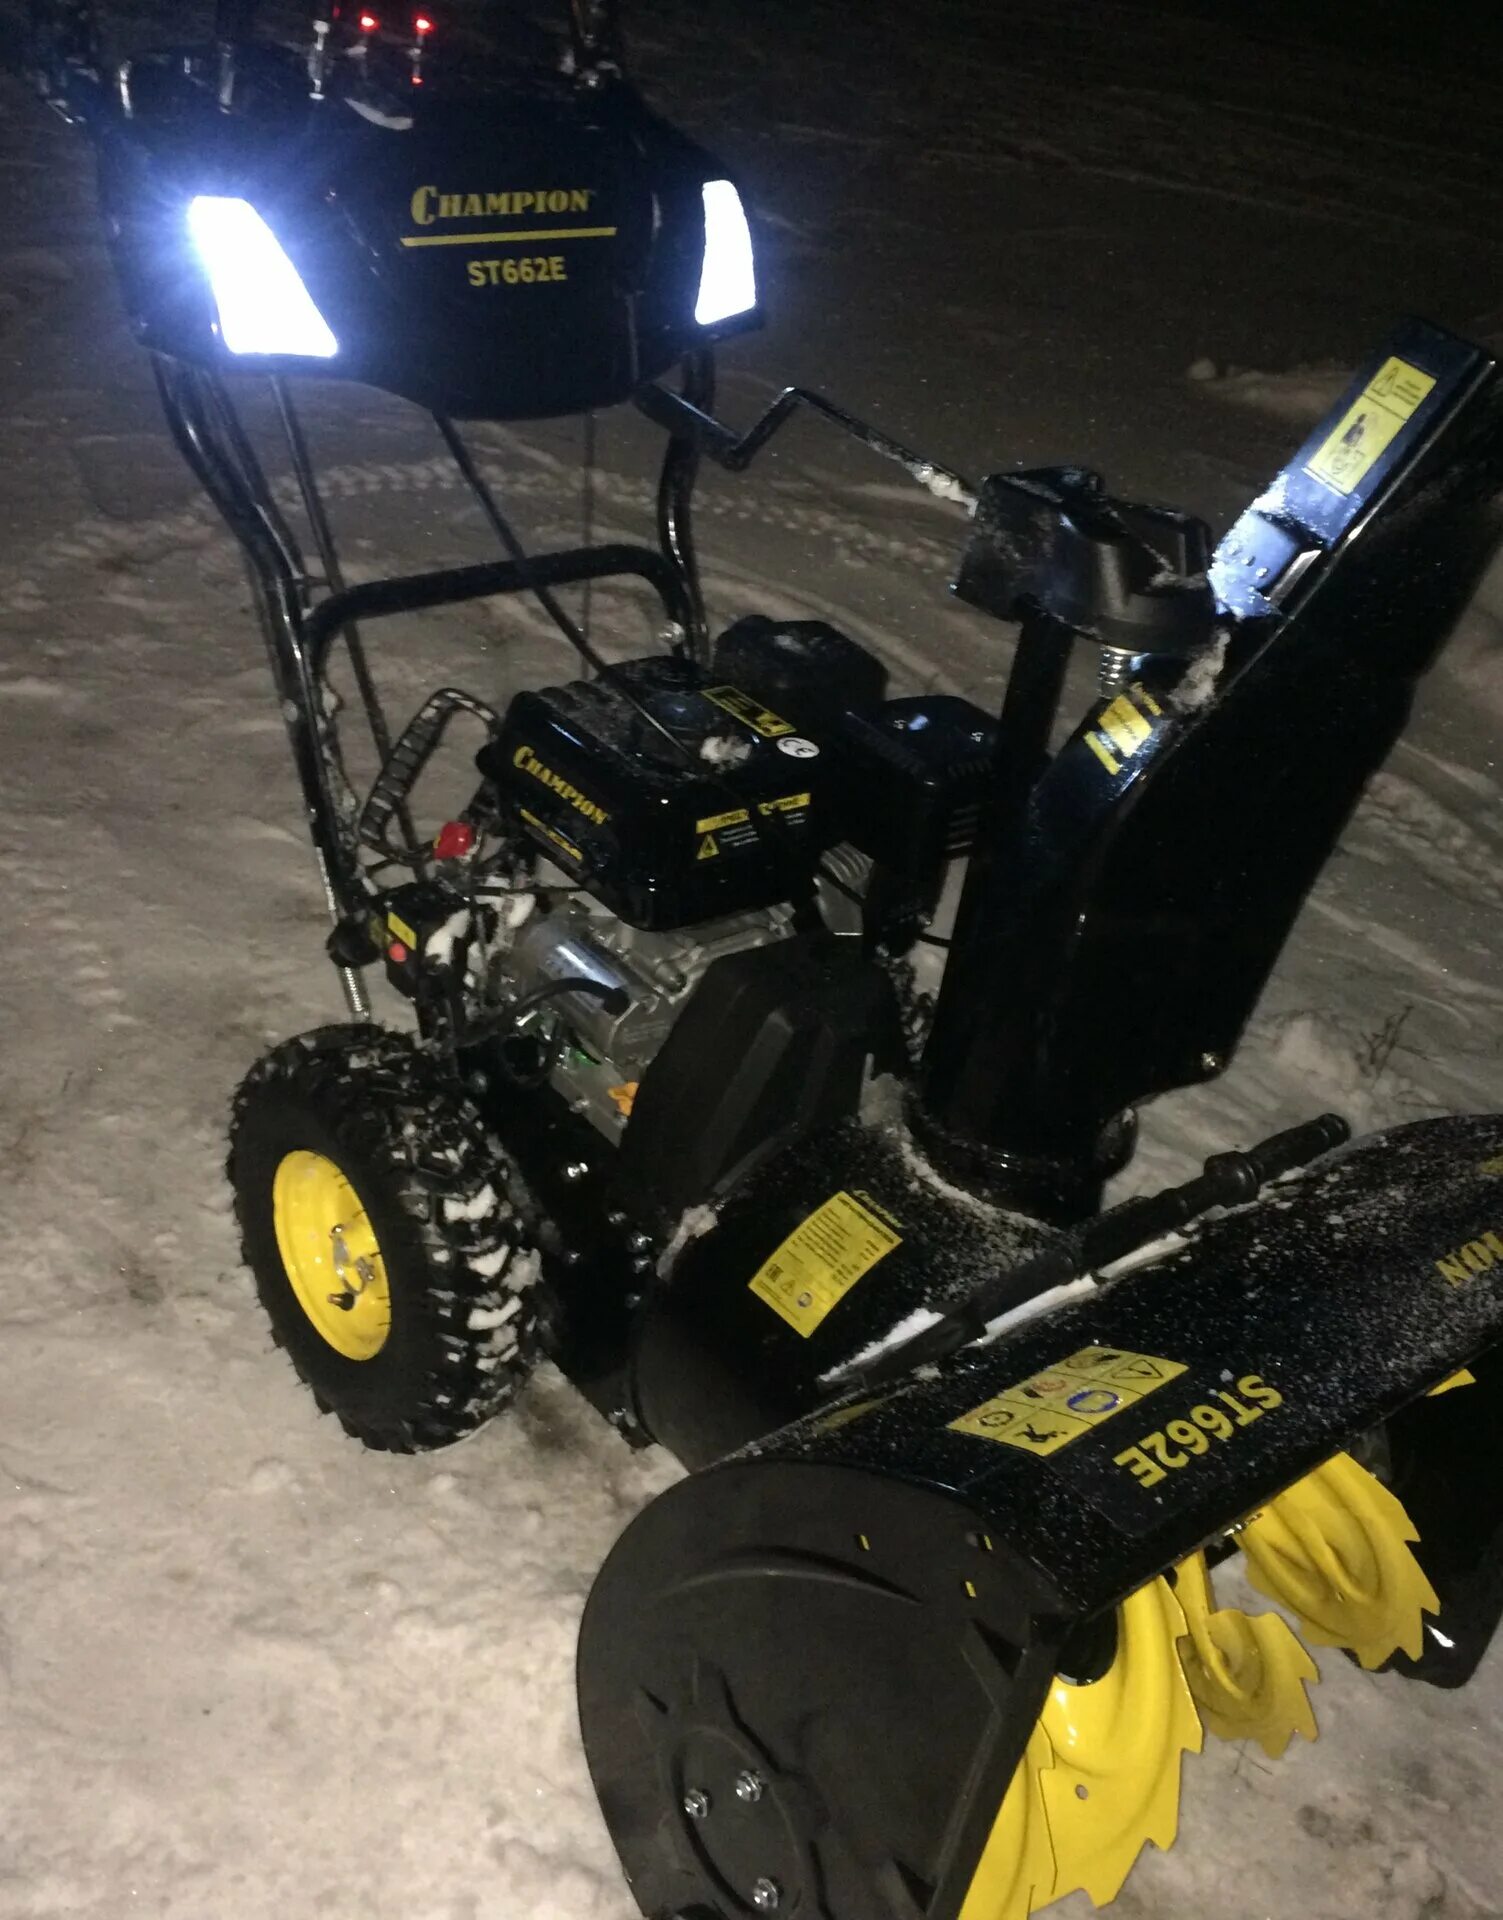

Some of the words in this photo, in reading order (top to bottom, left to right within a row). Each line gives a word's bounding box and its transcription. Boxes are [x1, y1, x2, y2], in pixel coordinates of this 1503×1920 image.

[410, 185, 590, 225] CHAMPION
[467, 256, 568, 287] ST662E
[513, 745, 609, 825] CHAMPION
[1112, 1375, 1283, 1488] ST662E
